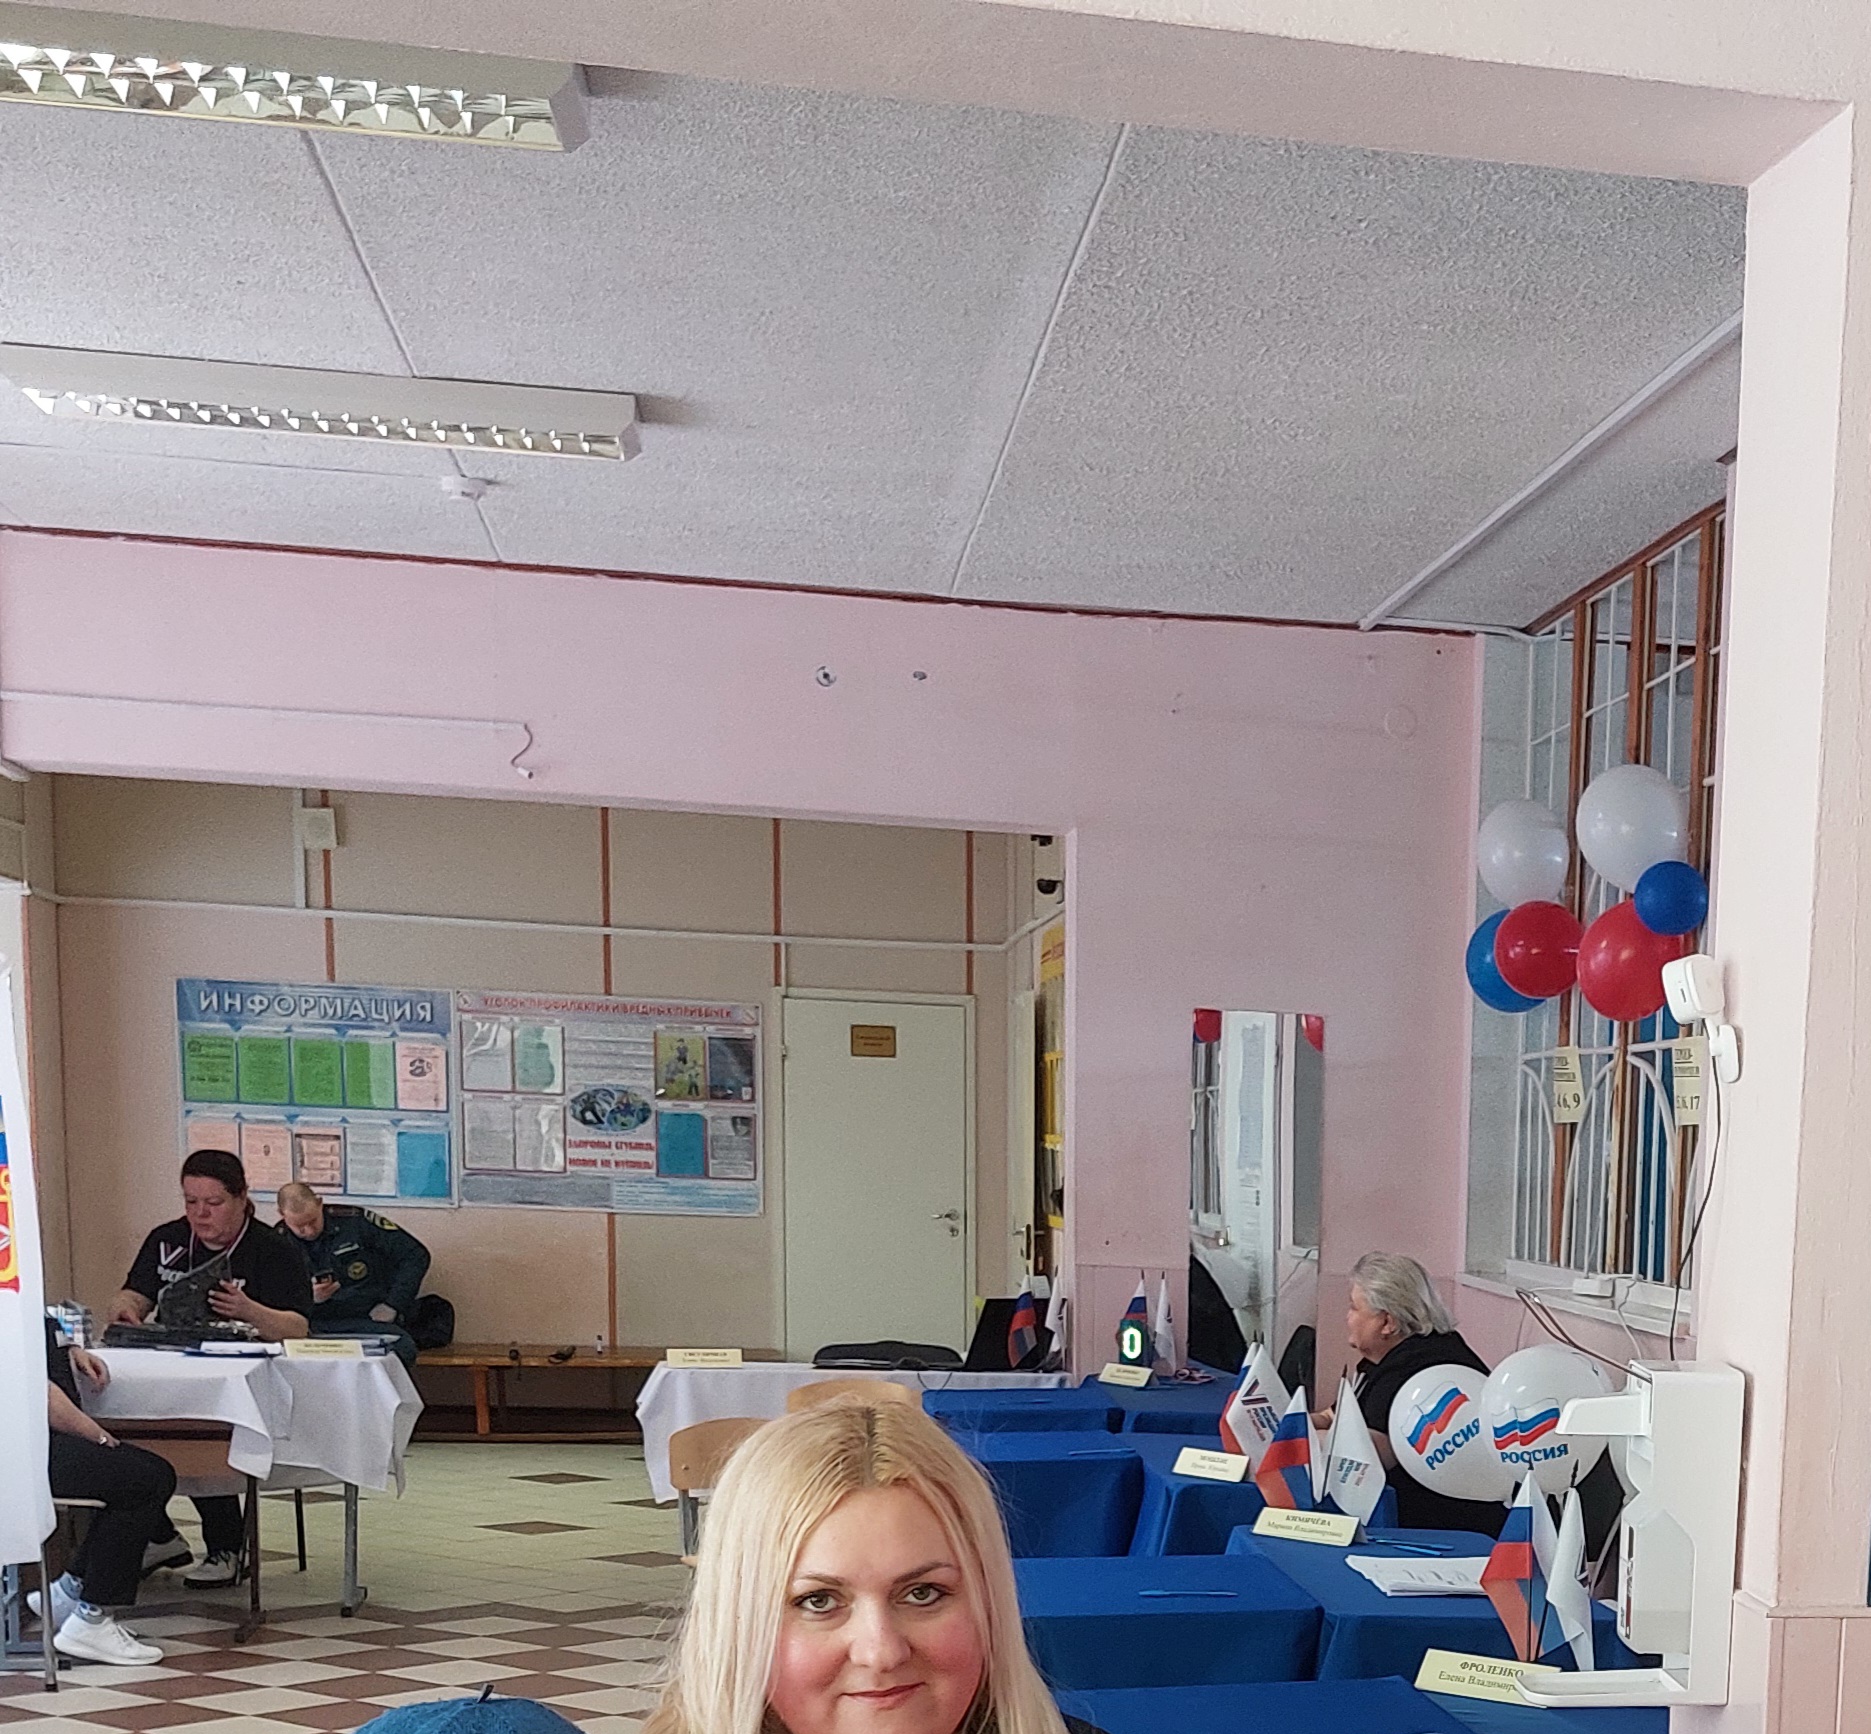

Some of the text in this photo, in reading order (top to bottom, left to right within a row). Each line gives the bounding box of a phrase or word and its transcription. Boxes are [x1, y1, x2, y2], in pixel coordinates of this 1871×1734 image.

[199, 990, 434, 1023] ИНФОРМАЦИЯ
[1122, 1327, 1142, 1359] 0
[1424, 1417, 1481, 1471] РОССИЯ
[1500, 1443, 1570, 1465] РОССИЯ
[1438, 1671, 1465, 1683] Елена
[1460, 1661, 1524, 1678] ФРОЛЕНКО
